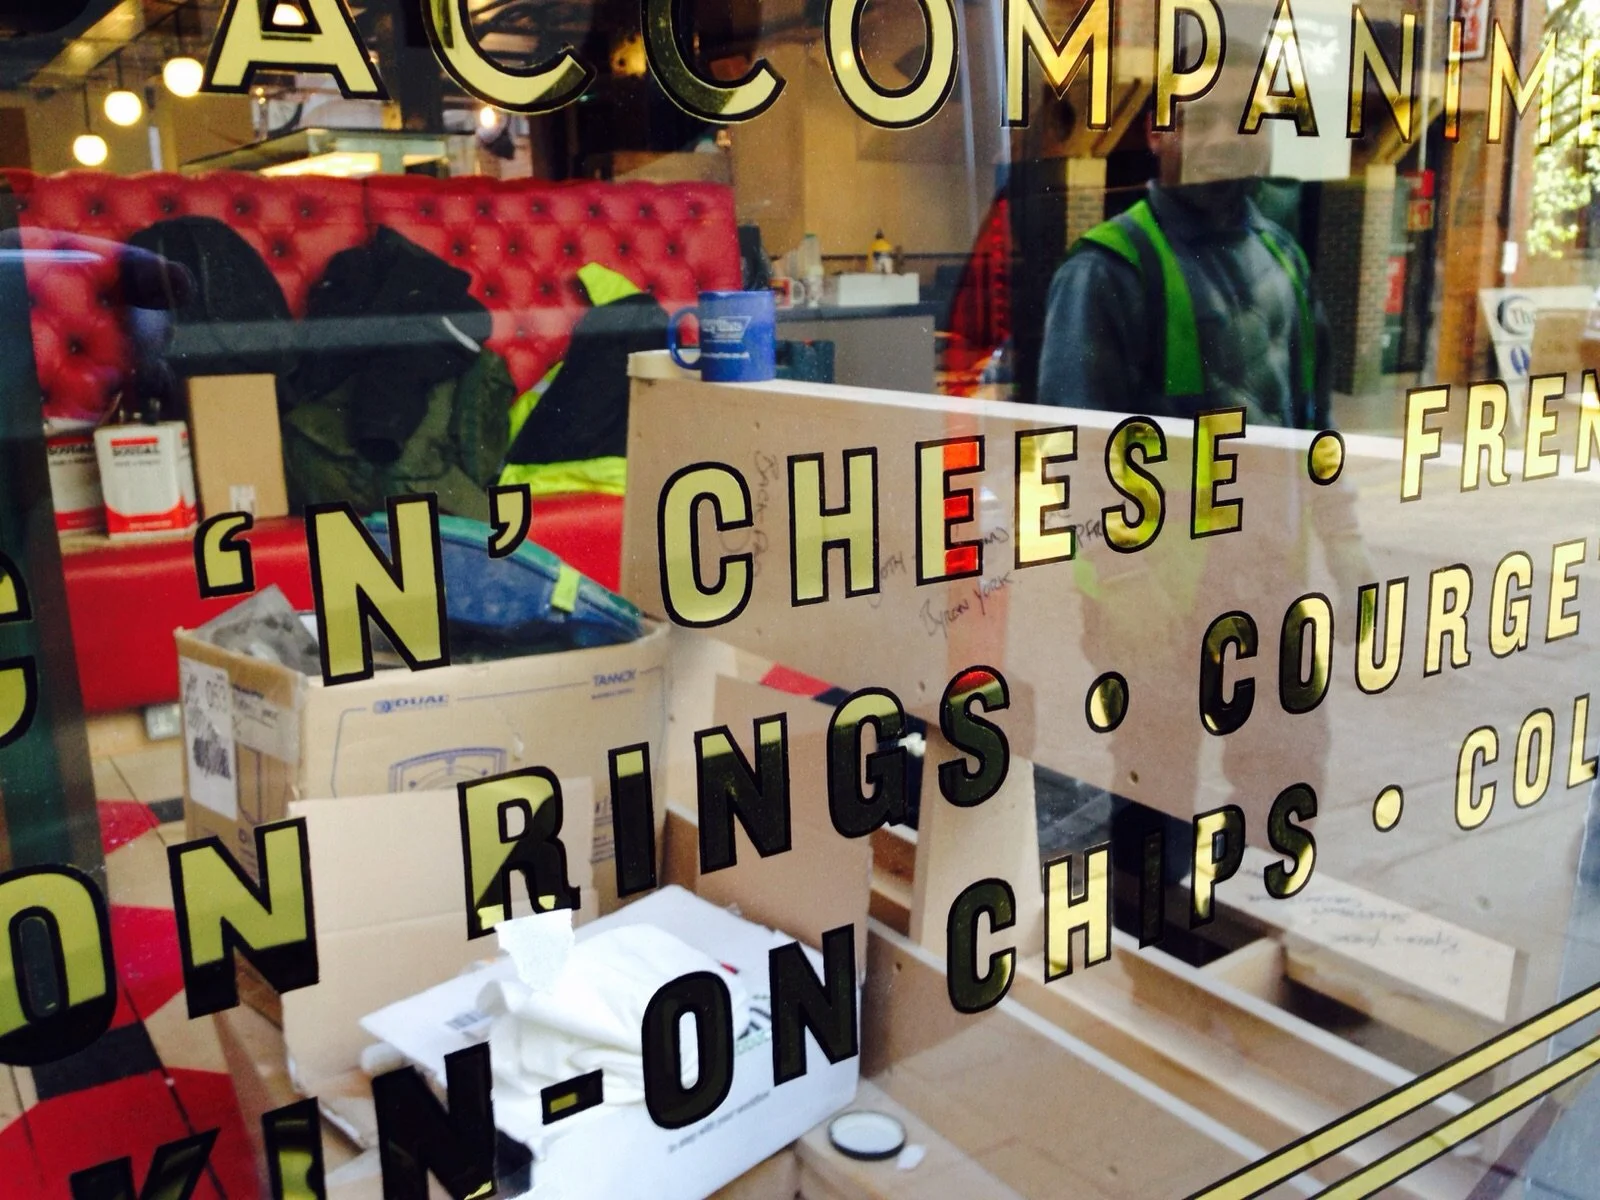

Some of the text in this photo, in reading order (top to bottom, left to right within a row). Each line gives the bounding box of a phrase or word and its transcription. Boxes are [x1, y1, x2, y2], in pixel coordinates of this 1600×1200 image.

[658, 408, 1247, 628] CHEESE
[458, 665, 1010, 940] RINGS
[1200, 537, 1600, 735] COURGE
[947, 782, 1318, 1014] CHIPS
[1455, 693, 1599, 831] COL
